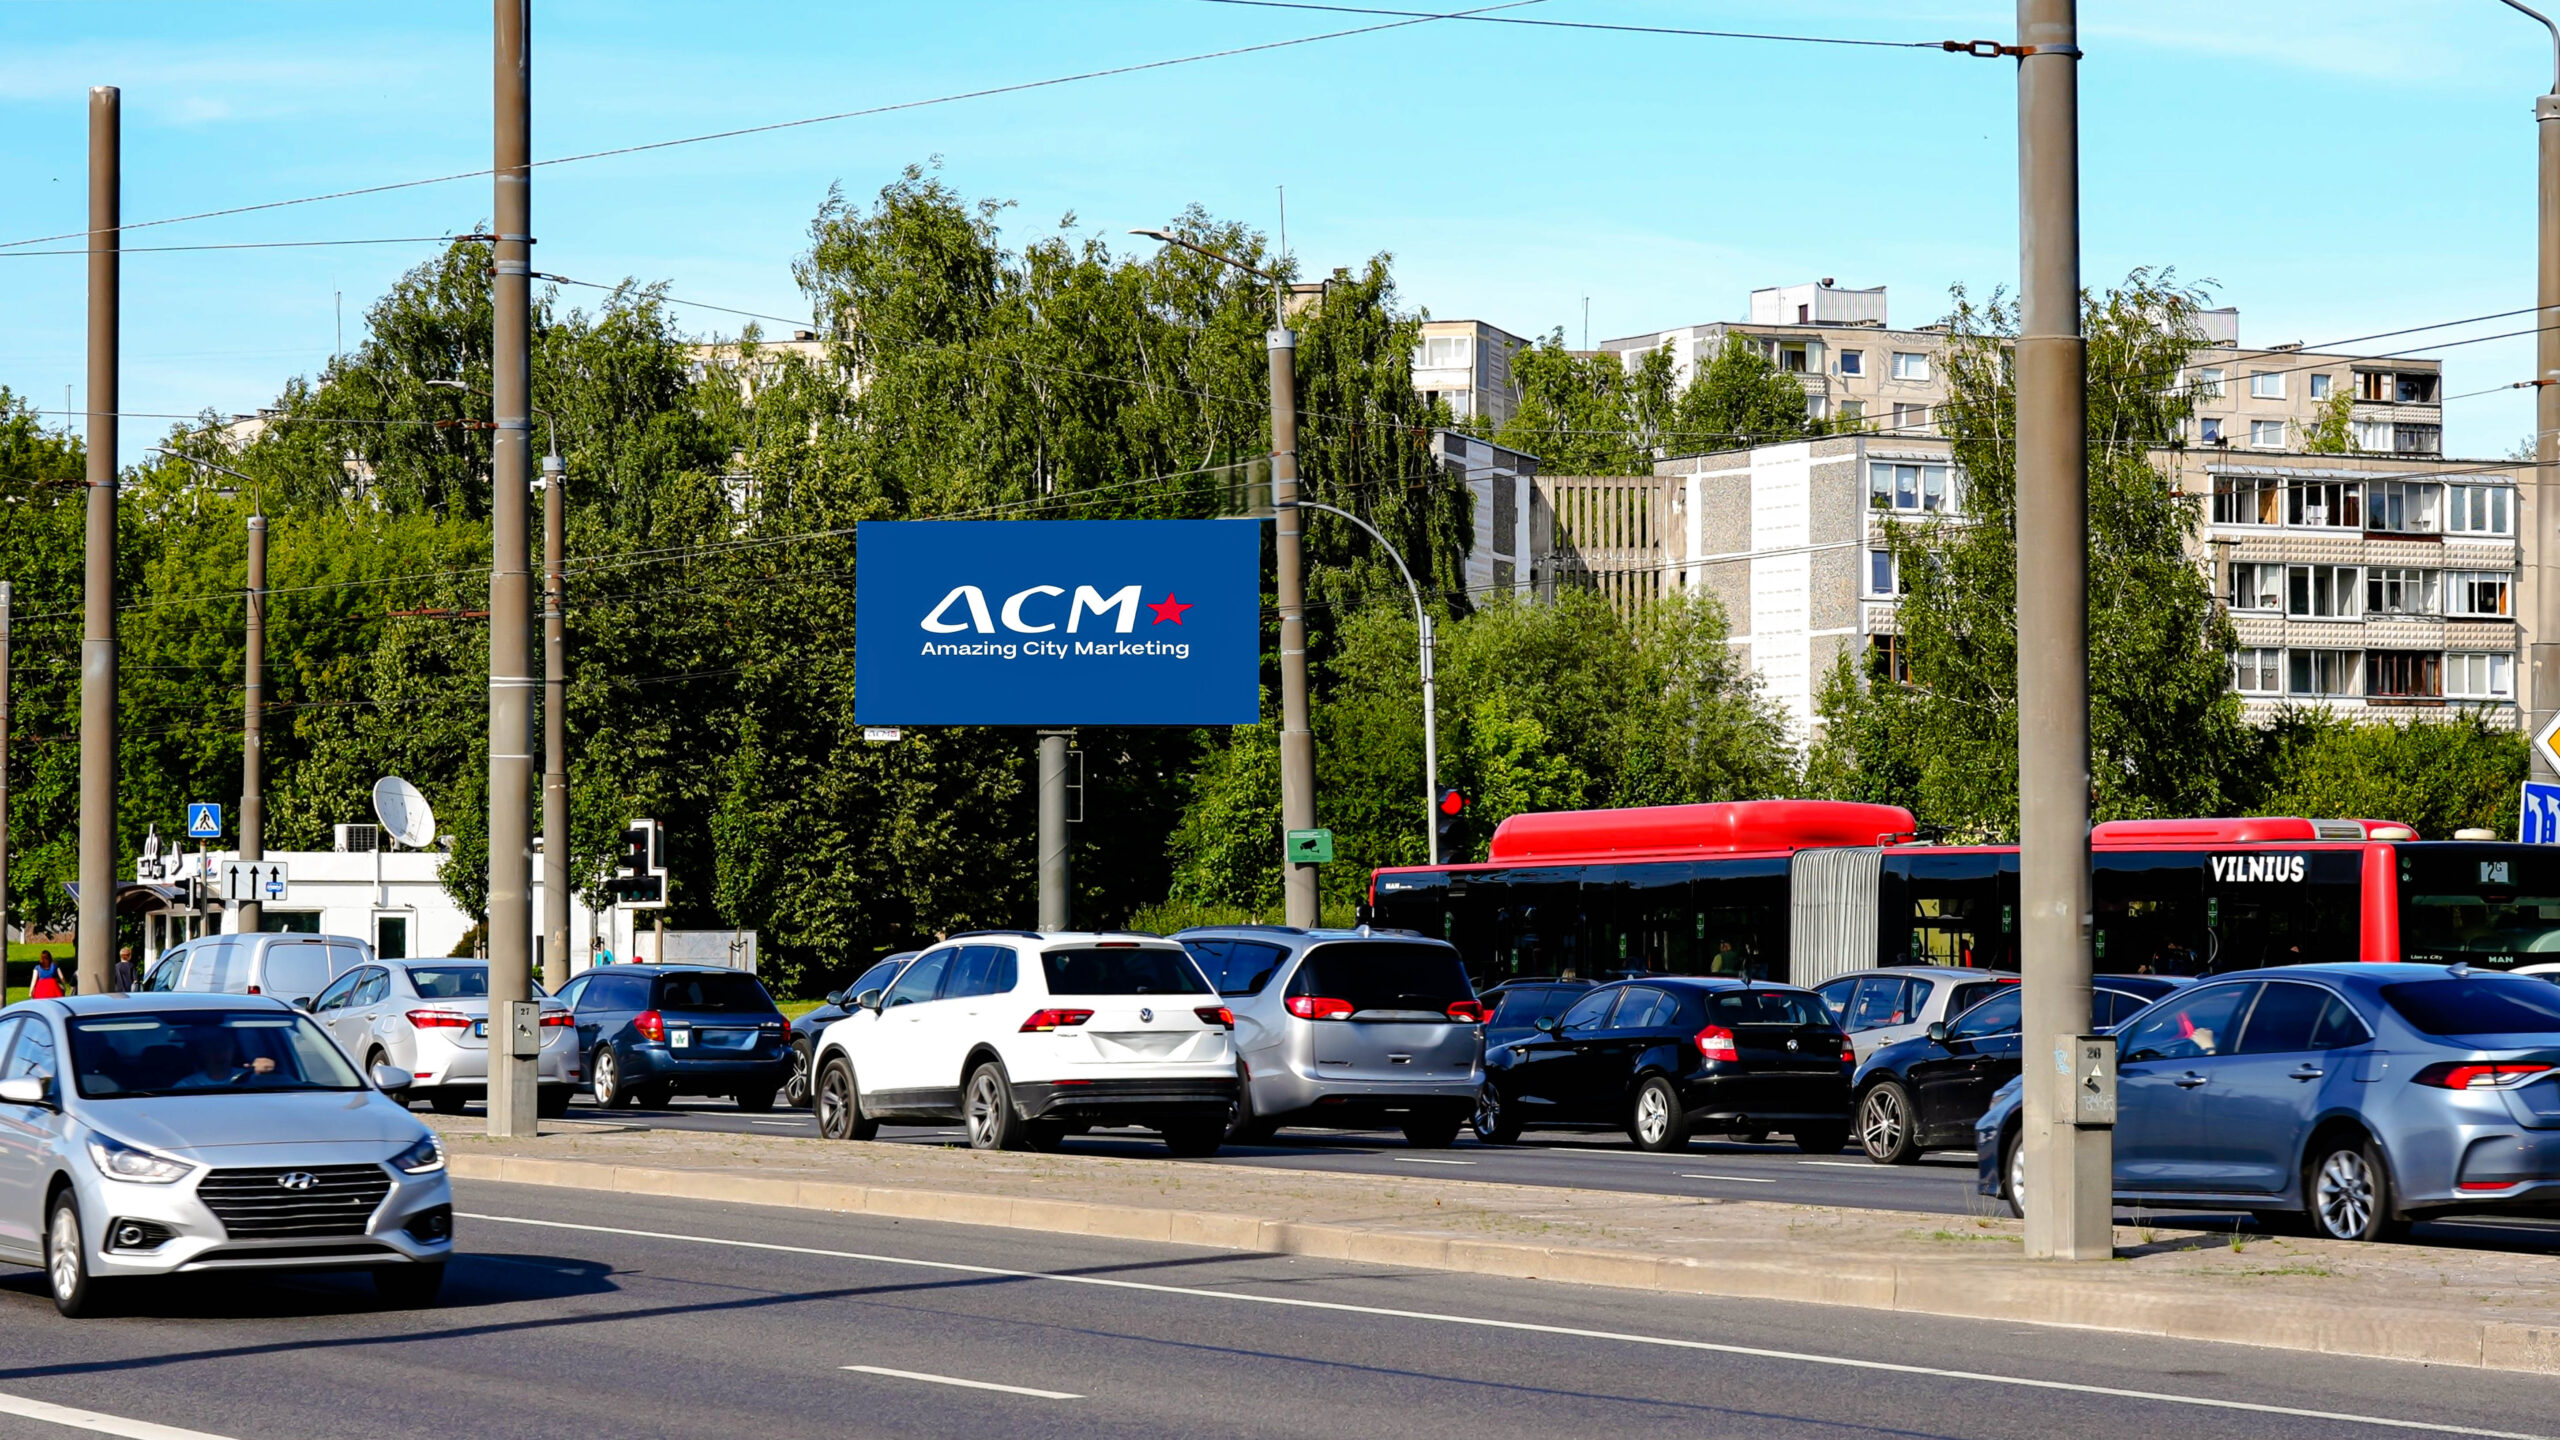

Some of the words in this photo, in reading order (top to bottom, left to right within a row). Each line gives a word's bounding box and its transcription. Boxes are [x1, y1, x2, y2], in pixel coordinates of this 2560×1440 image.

[920, 585, 1142, 634] ACM
[921, 641, 1017, 659] Amazing
[1023, 641, 1068, 659] City
[1075, 641, 1189, 659] Marketing
[2211, 856, 2305, 882] VILNIUS
[520, 1007, 530, 1016] 27
